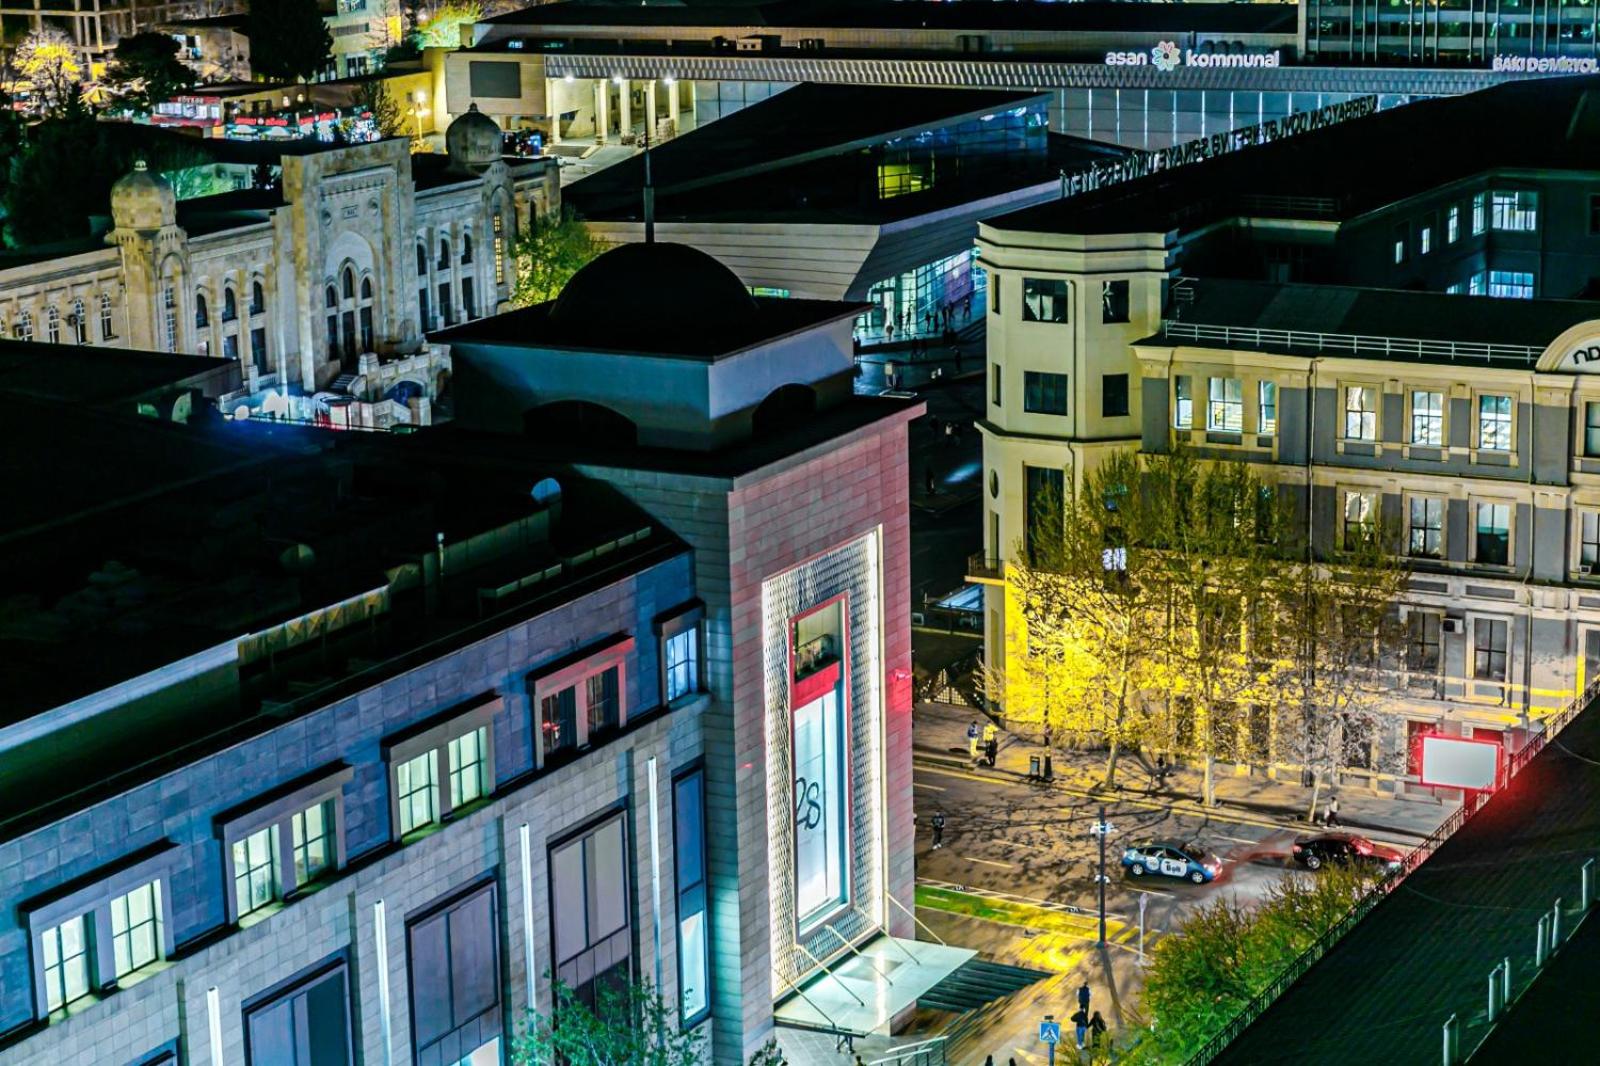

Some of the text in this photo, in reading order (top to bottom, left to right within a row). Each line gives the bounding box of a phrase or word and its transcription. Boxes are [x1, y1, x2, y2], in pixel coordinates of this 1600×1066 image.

[1105, 49, 1280, 67] asan kommunal
[1492, 56, 1525, 72] BAKI
